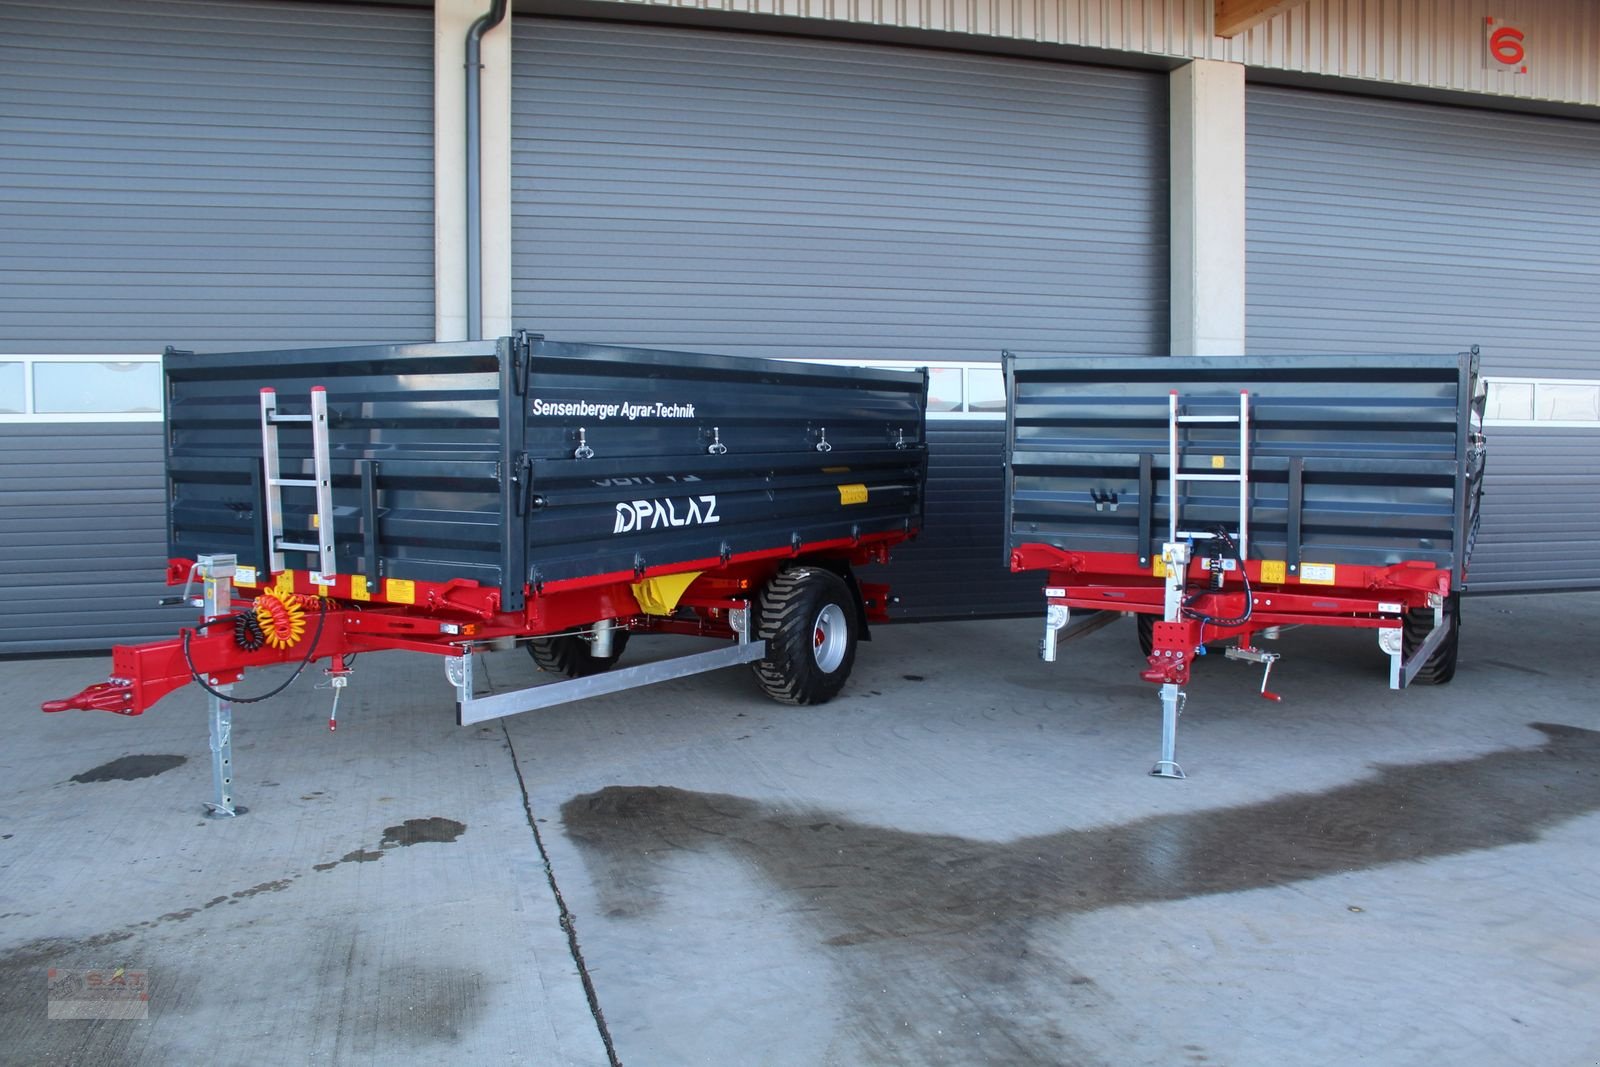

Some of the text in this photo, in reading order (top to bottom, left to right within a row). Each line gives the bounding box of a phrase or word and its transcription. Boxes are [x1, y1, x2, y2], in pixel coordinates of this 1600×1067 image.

[1490, 27, 1524, 65] 6
[533, 399, 695, 420] Sensenberger Agrar-Technik
